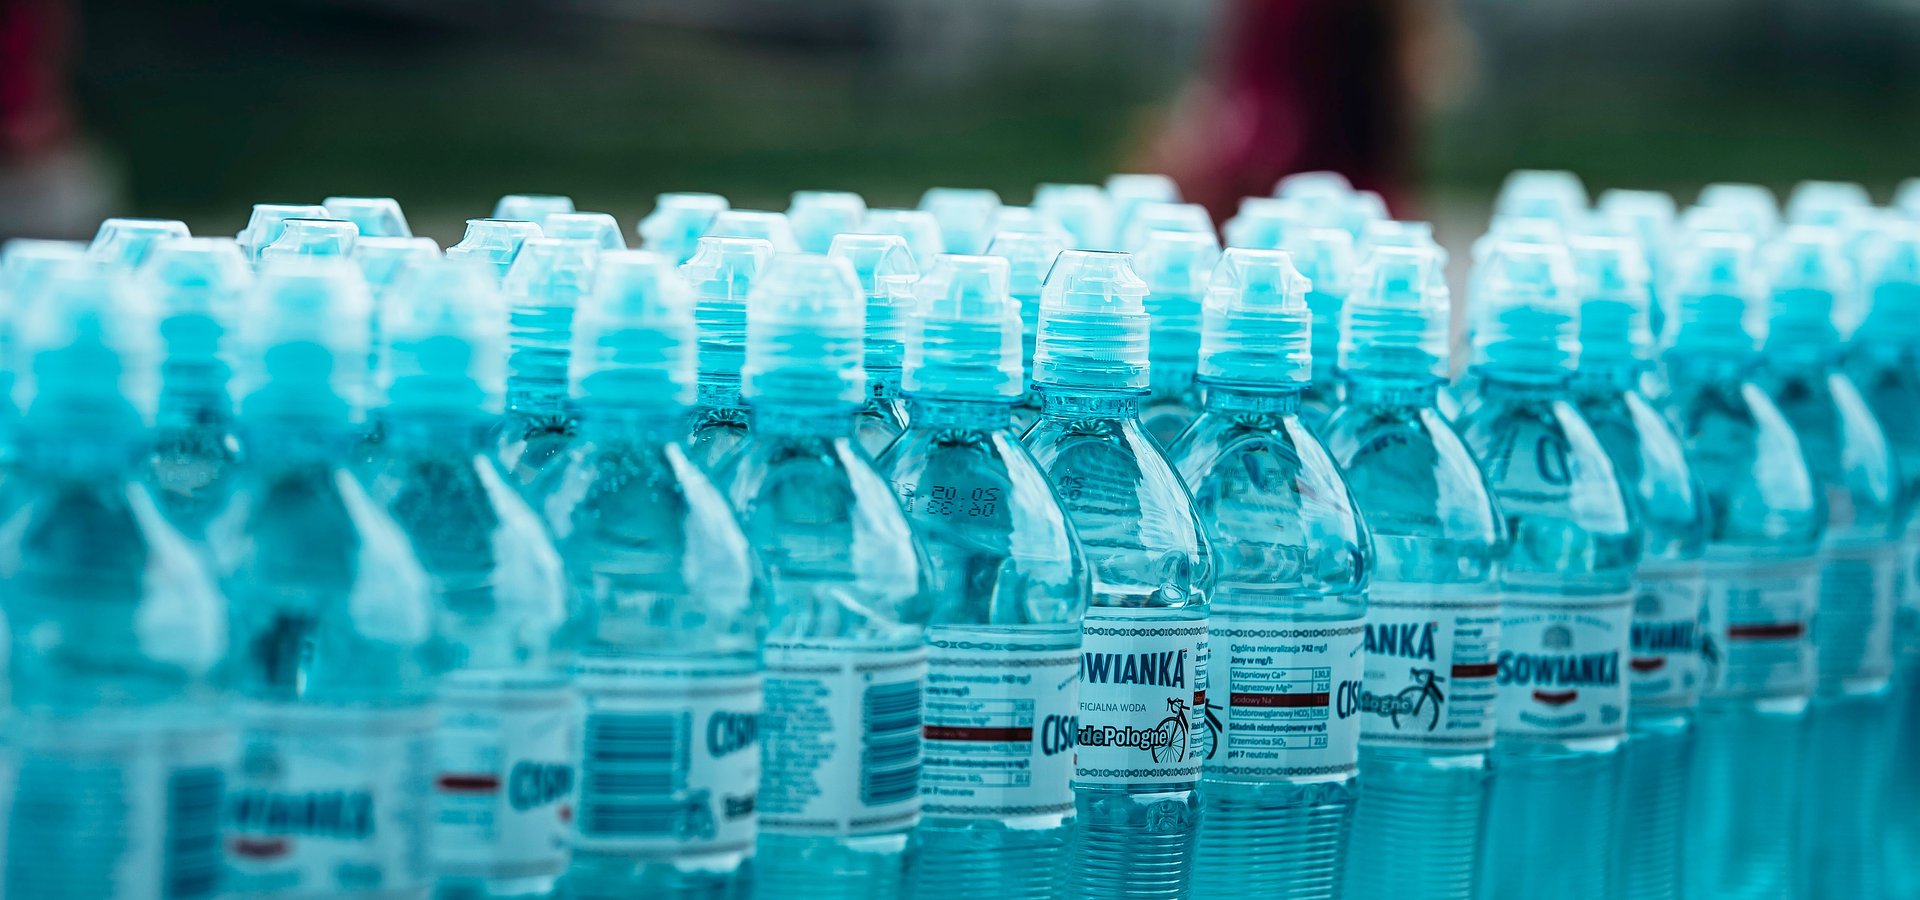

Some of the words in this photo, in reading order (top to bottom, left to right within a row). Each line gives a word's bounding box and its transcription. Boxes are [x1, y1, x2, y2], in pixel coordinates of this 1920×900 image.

[1230, 644, 1256, 653] Ogólna
[1257, 644, 1300, 654] mineralizacja
[1301, 644, 1313, 653] 742
[1314, 643, 1327, 654] mg/l
[1230, 656, 1246, 665] Jony
[1232, 671, 1270, 680] Wapniowy
[1232, 683, 1275, 692] Magnezowy
[1080, 702, 1118, 712] FICJALNA
[1120, 703, 1147, 713] WODA
[1230, 737, 1270, 746] Krzemionka
[1228, 751, 1239, 760] pH
[1246, 751, 1279, 760] neutralne
